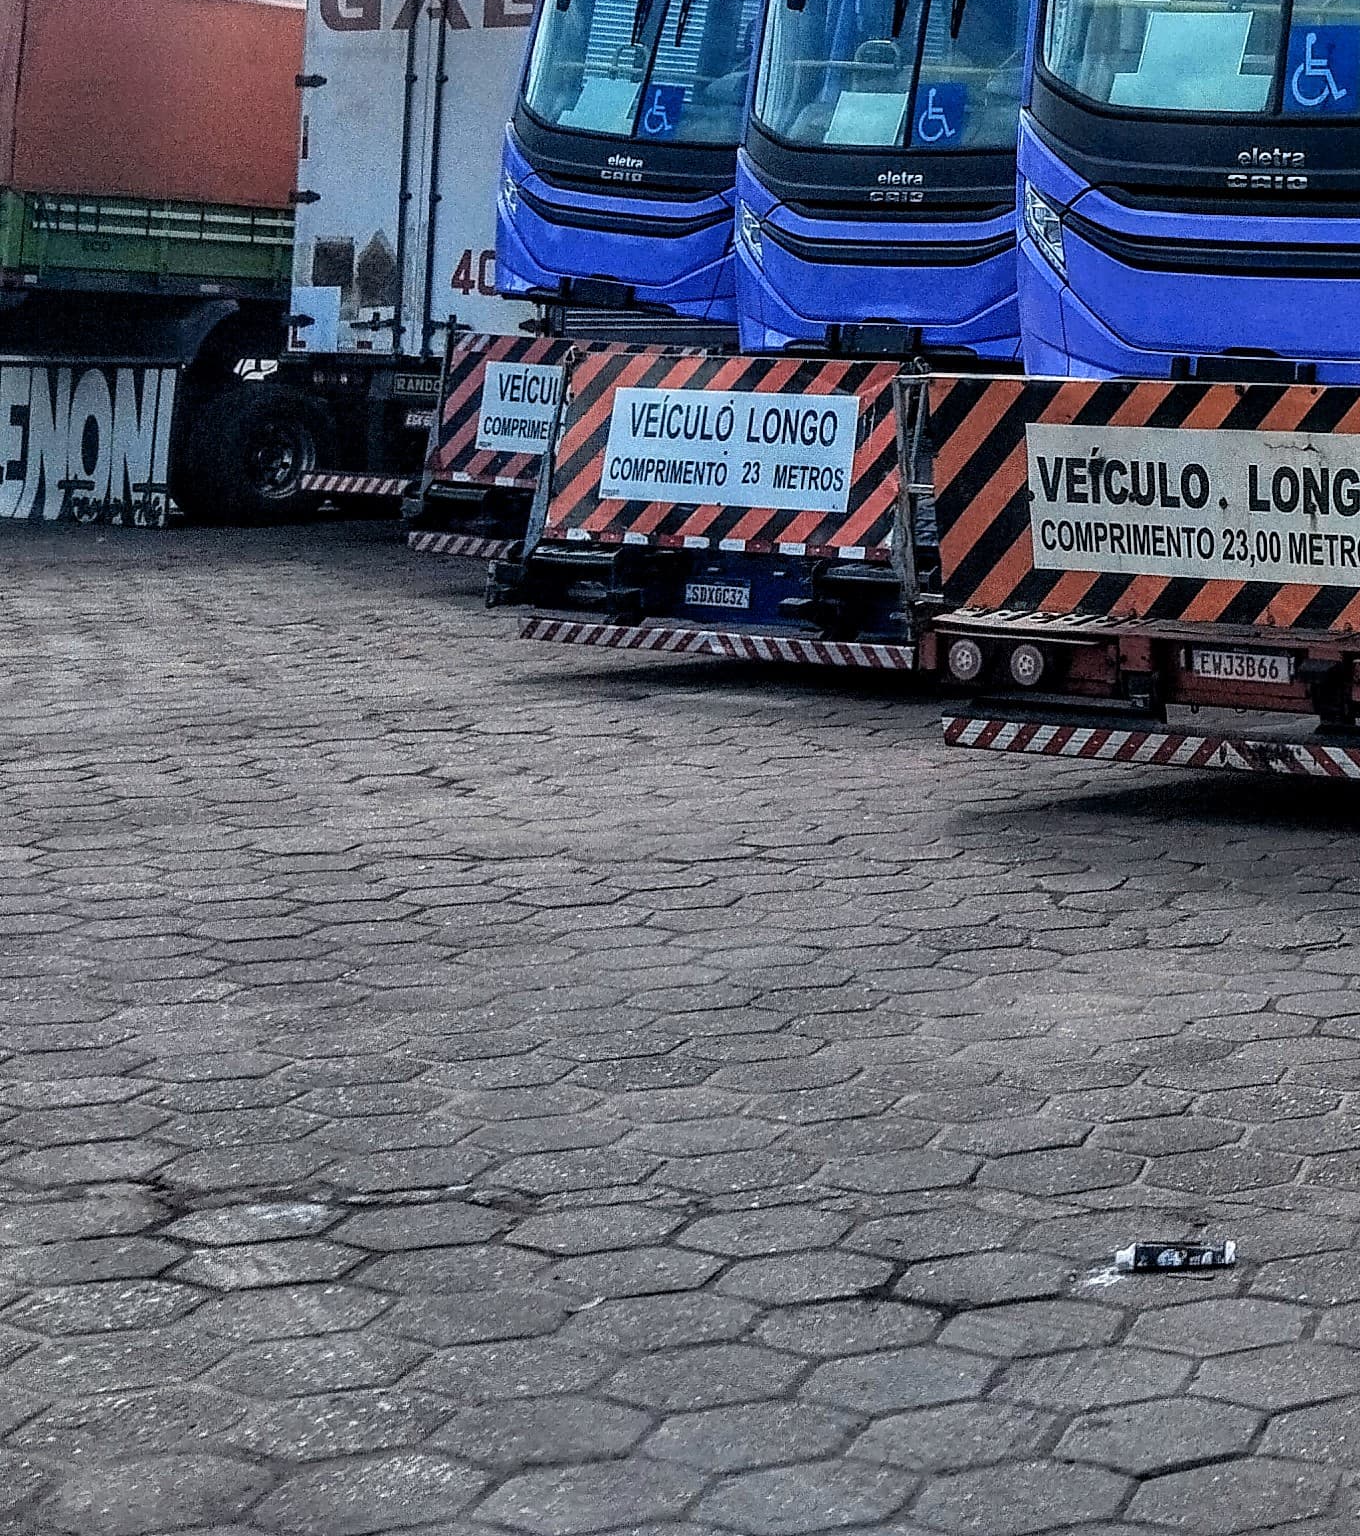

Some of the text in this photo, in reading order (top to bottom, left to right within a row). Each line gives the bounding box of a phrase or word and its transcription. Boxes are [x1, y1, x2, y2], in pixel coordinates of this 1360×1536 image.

[607, 153, 644, 168] eletra
[1237, 147, 1306, 167] eletra
[600, 169, 643, 182] CAIO
[877, 170, 924, 185] eletra
[1227, 174, 1308, 190] CAIO
[396, 378, 441, 392] RANDO
[483, 416, 555, 440] COMPRIME
[630, 395, 838, 447] VEÍCULO LONGO
[609, 456, 844, 492] COMPRIMENTO 23 METROS
[1037, 447, 1210, 509] VEÍCULO
[1040, 519, 1215, 560] COMPRIMENTO
[1222, 528, 1282, 568] 23,00
